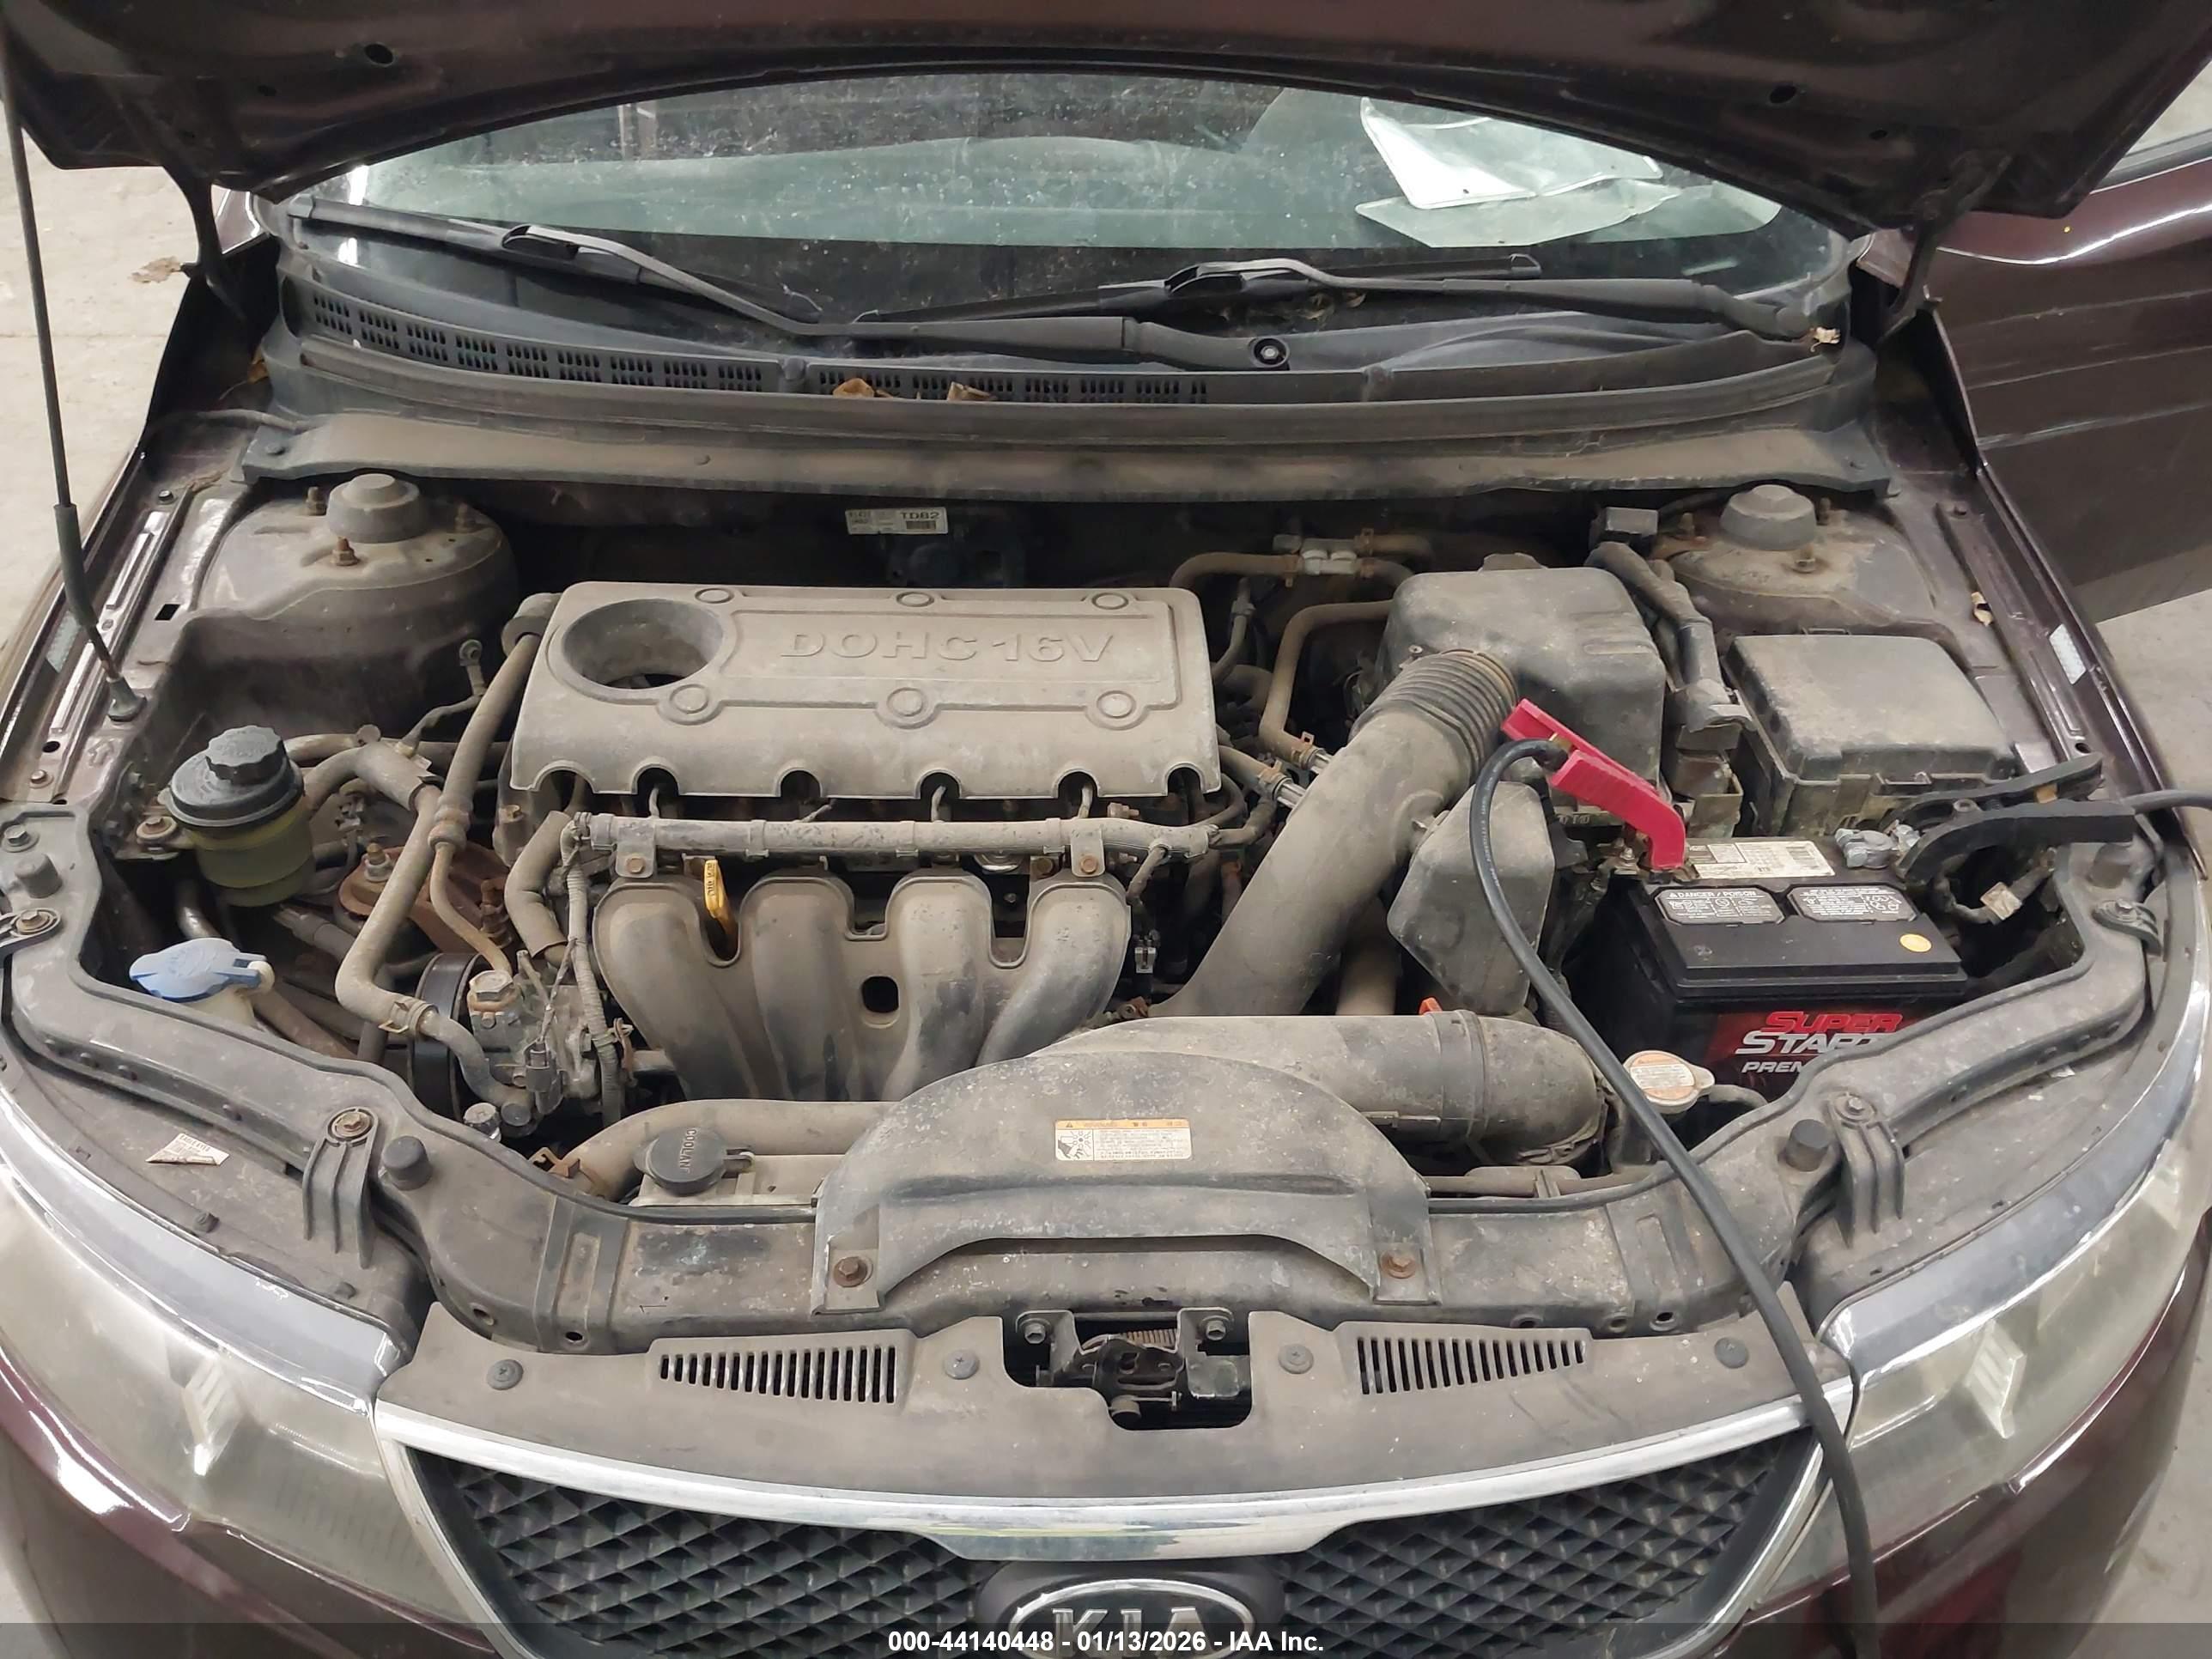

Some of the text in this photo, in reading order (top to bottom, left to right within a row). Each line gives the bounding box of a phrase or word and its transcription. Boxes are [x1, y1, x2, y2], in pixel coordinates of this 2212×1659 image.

[780, 631, 1115, 662] DOHC 16V
[1760, 1012, 1903, 1033] SUPER
[1051, 1607, 1210, 1658] KIA
